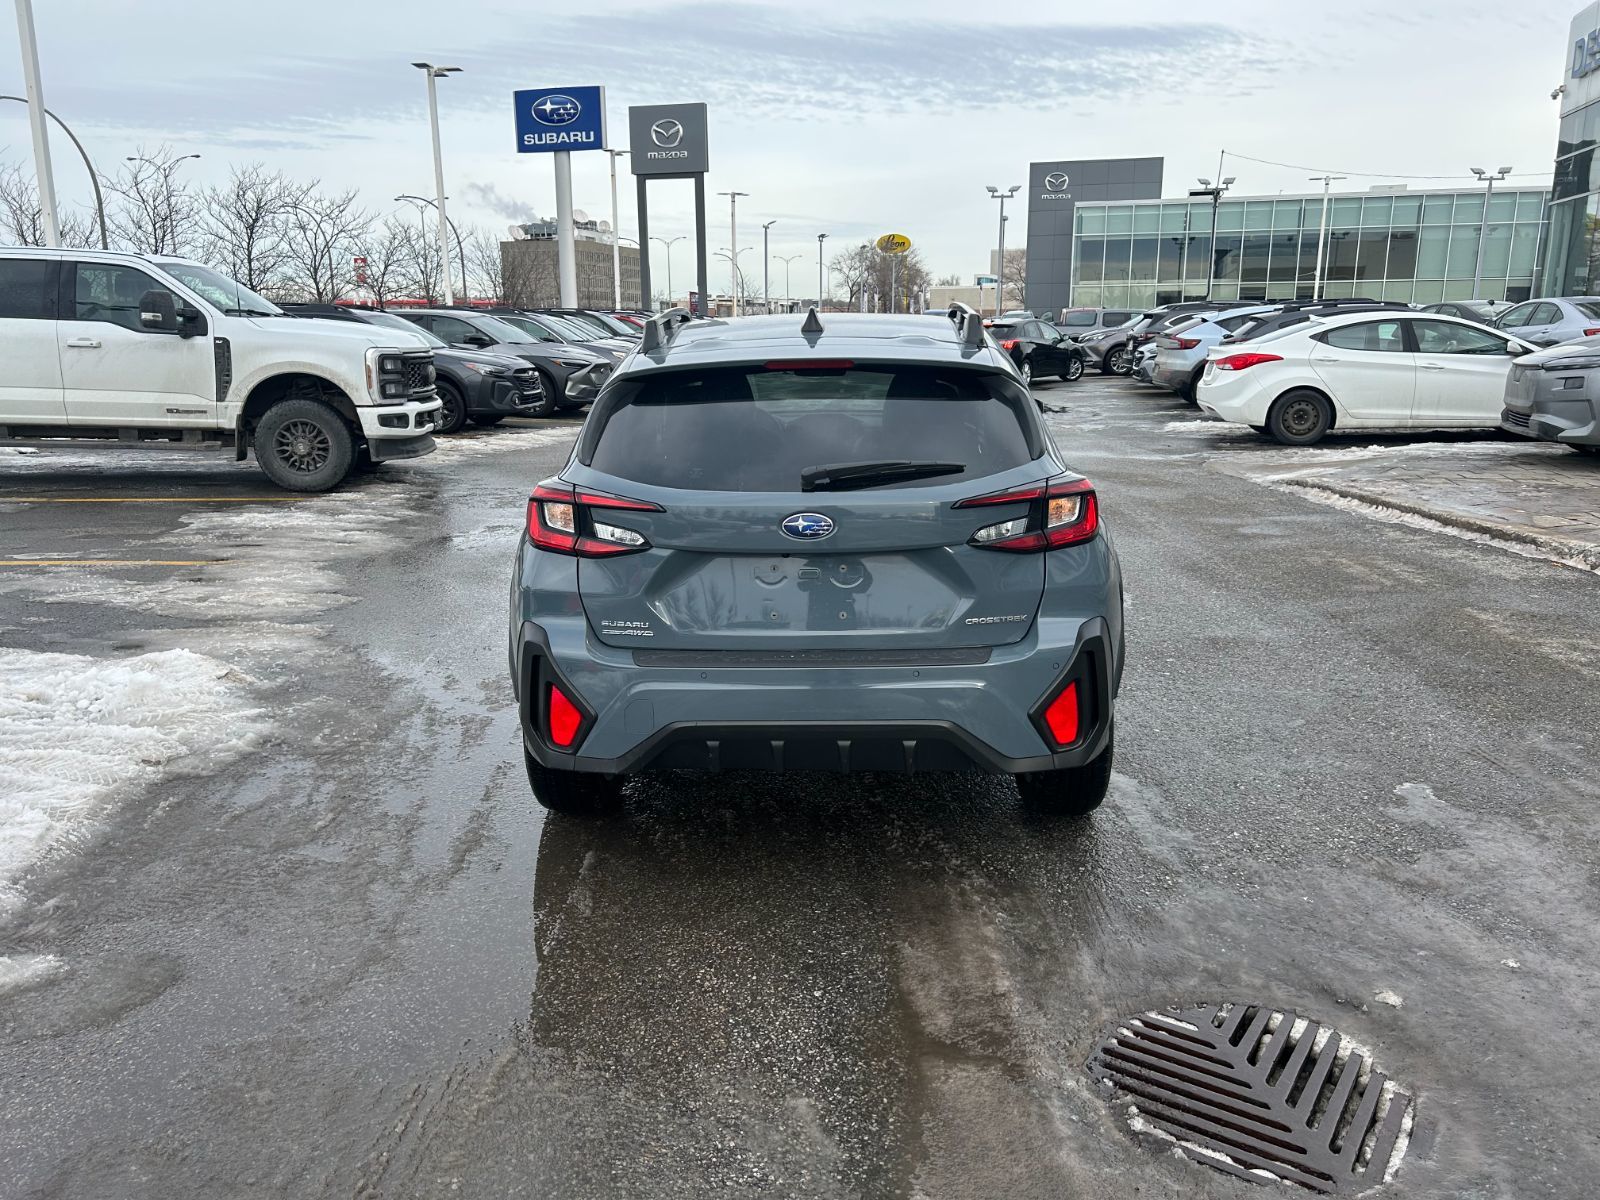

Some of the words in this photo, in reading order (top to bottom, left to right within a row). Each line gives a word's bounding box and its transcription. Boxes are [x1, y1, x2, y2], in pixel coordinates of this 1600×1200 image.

[1571, 27, 1600, 79] DE
[523, 131, 595, 145] SUBARU
[647, 150, 688, 159] mazda
[601, 620, 649, 628] SUBARU
[965, 614, 1028, 625] CROSSTREK
